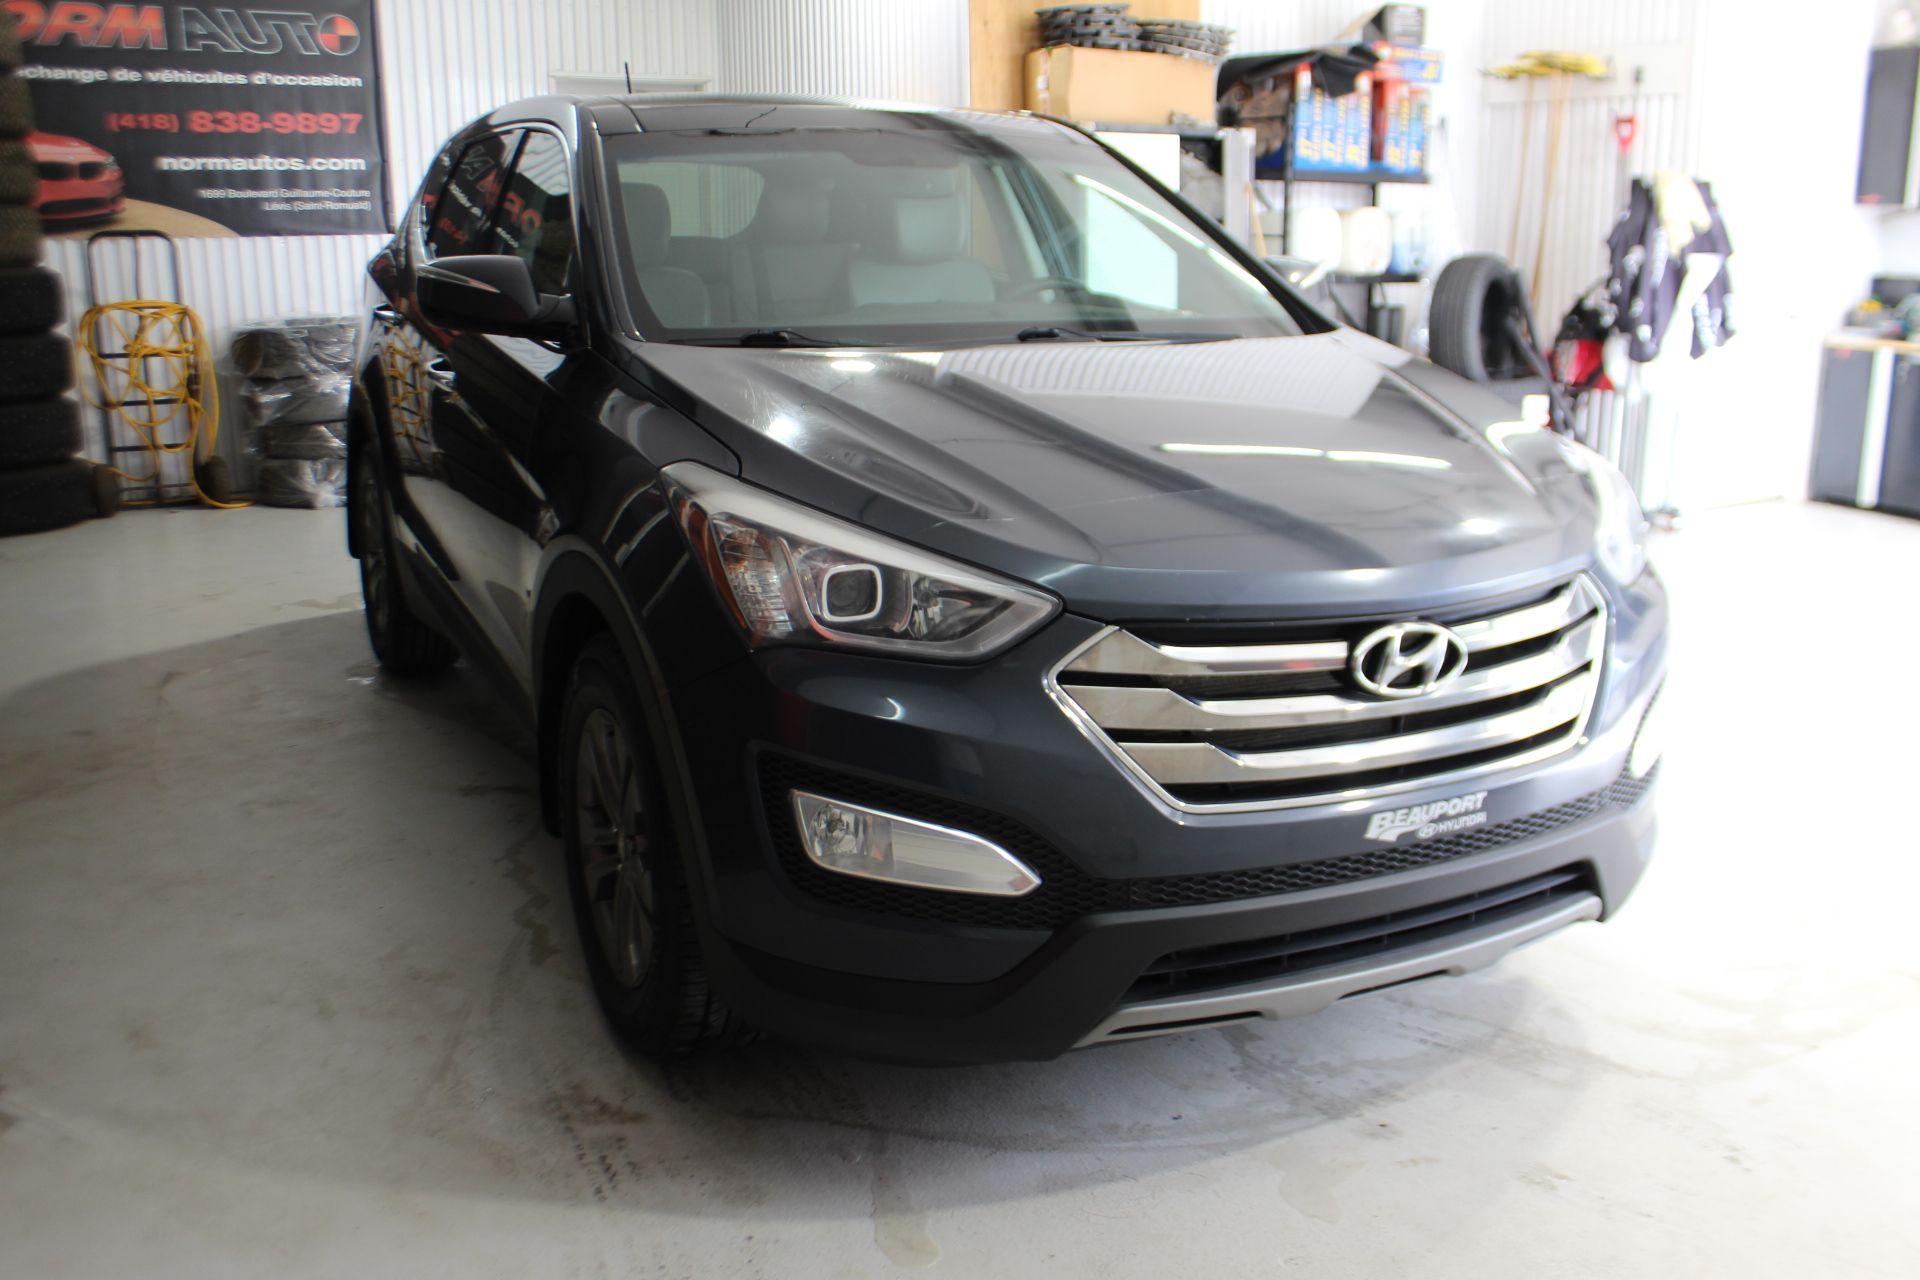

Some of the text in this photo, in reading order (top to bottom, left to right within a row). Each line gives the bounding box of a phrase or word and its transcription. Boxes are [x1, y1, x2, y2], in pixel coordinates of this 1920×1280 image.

[113, 69, 142, 82] de
[149, 70, 248, 86] véhicules
[255, 73, 363, 88] d'occasion
[108, 111, 363, 134] (418) 838-9897
[158, 154, 367, 171] normautos.com
[1364, 791, 1488, 842] BEAUPORT
[1438, 811, 1488, 833] HYUNDAI
